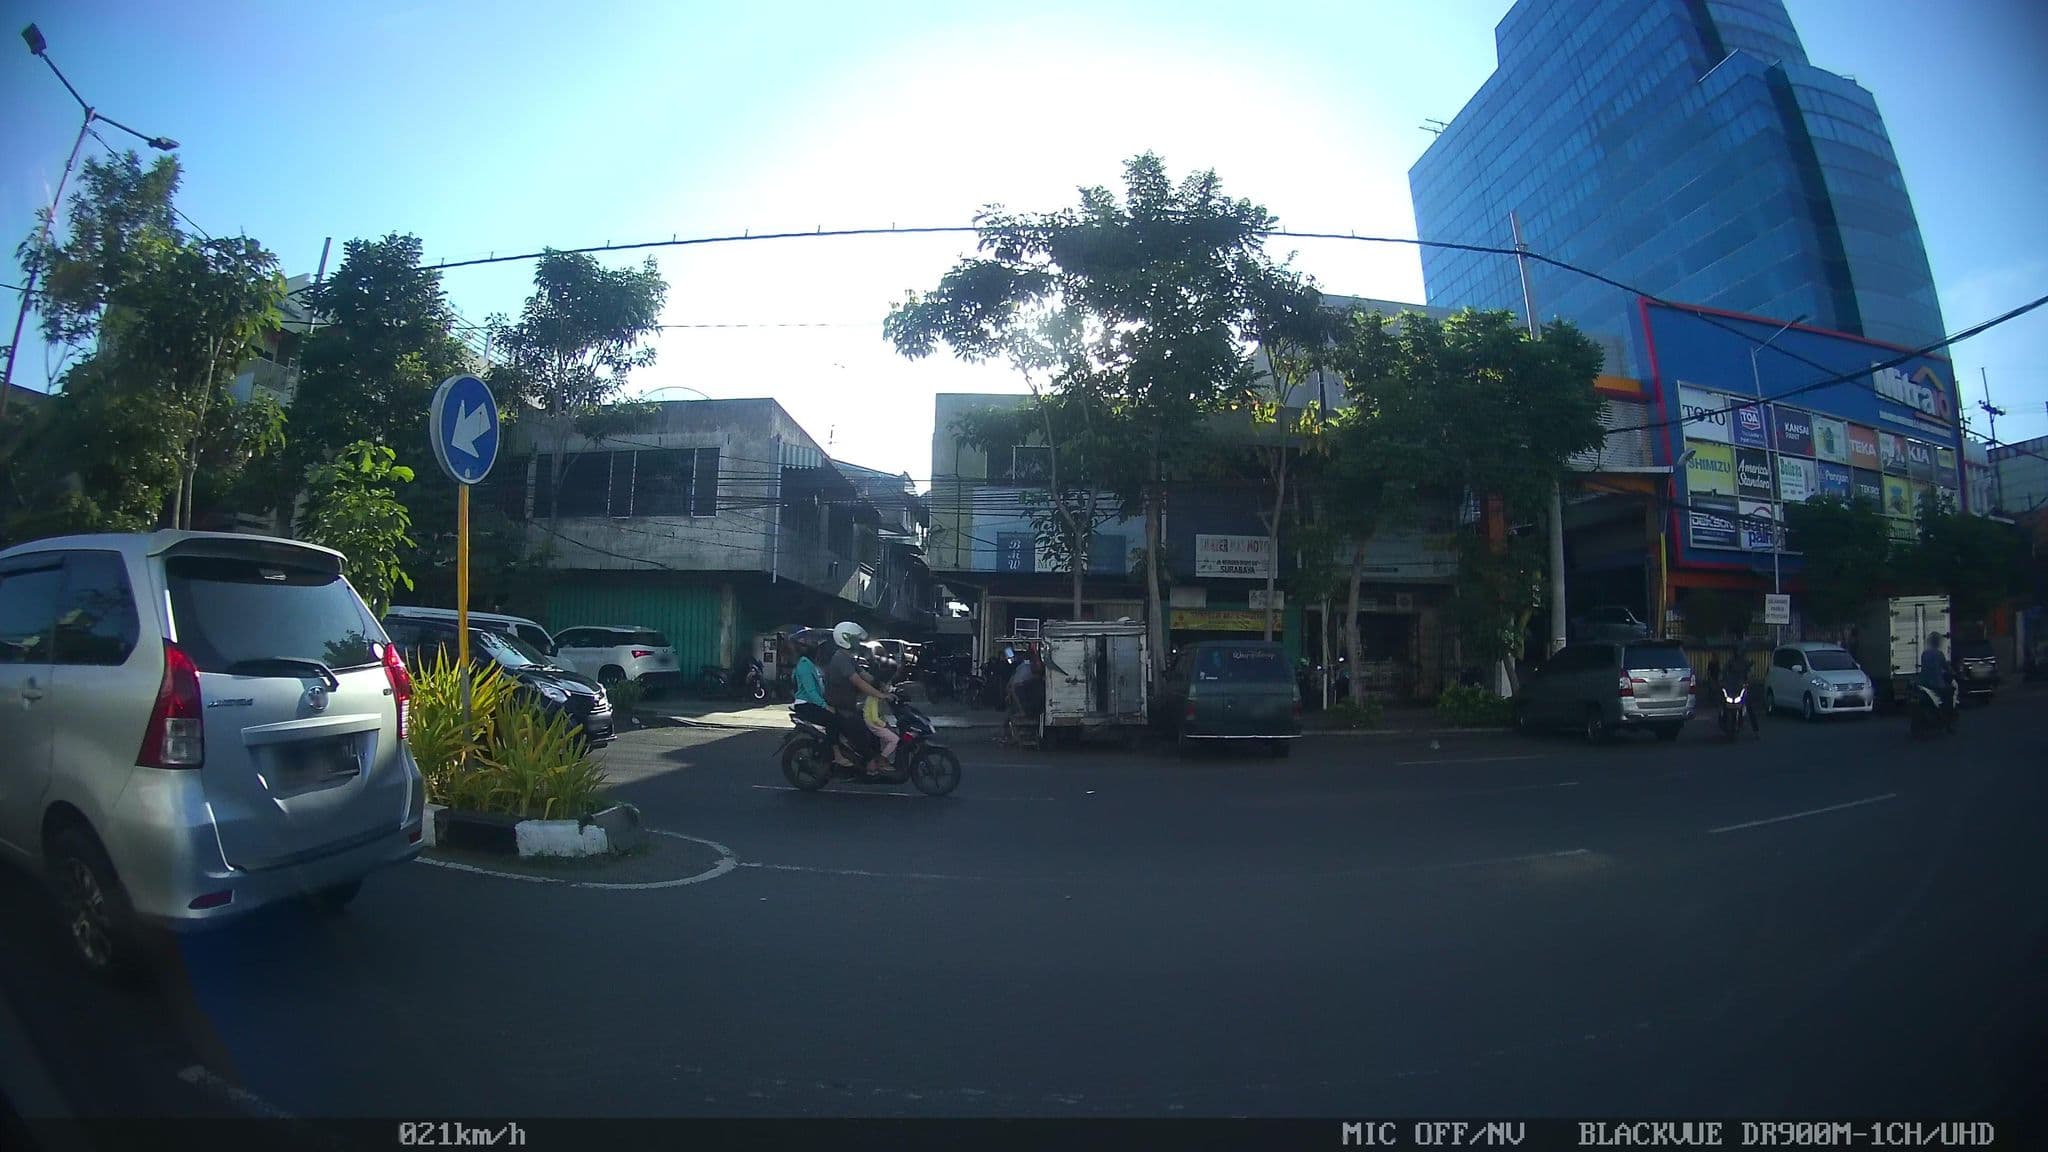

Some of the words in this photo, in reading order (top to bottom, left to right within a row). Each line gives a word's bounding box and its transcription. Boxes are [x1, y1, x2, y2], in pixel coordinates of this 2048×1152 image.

[1682, 404, 1726, 426] TOTO
[1741, 411, 1758, 423] TOA
[1784, 422, 1809, 435] KANSAI
[1851, 439, 1877, 456] TEKA
[1908, 444, 1930, 464] KIA
[1688, 457, 1731, 473] SHIMIZU
[1220, 565, 1256, 575] SURABAYA
